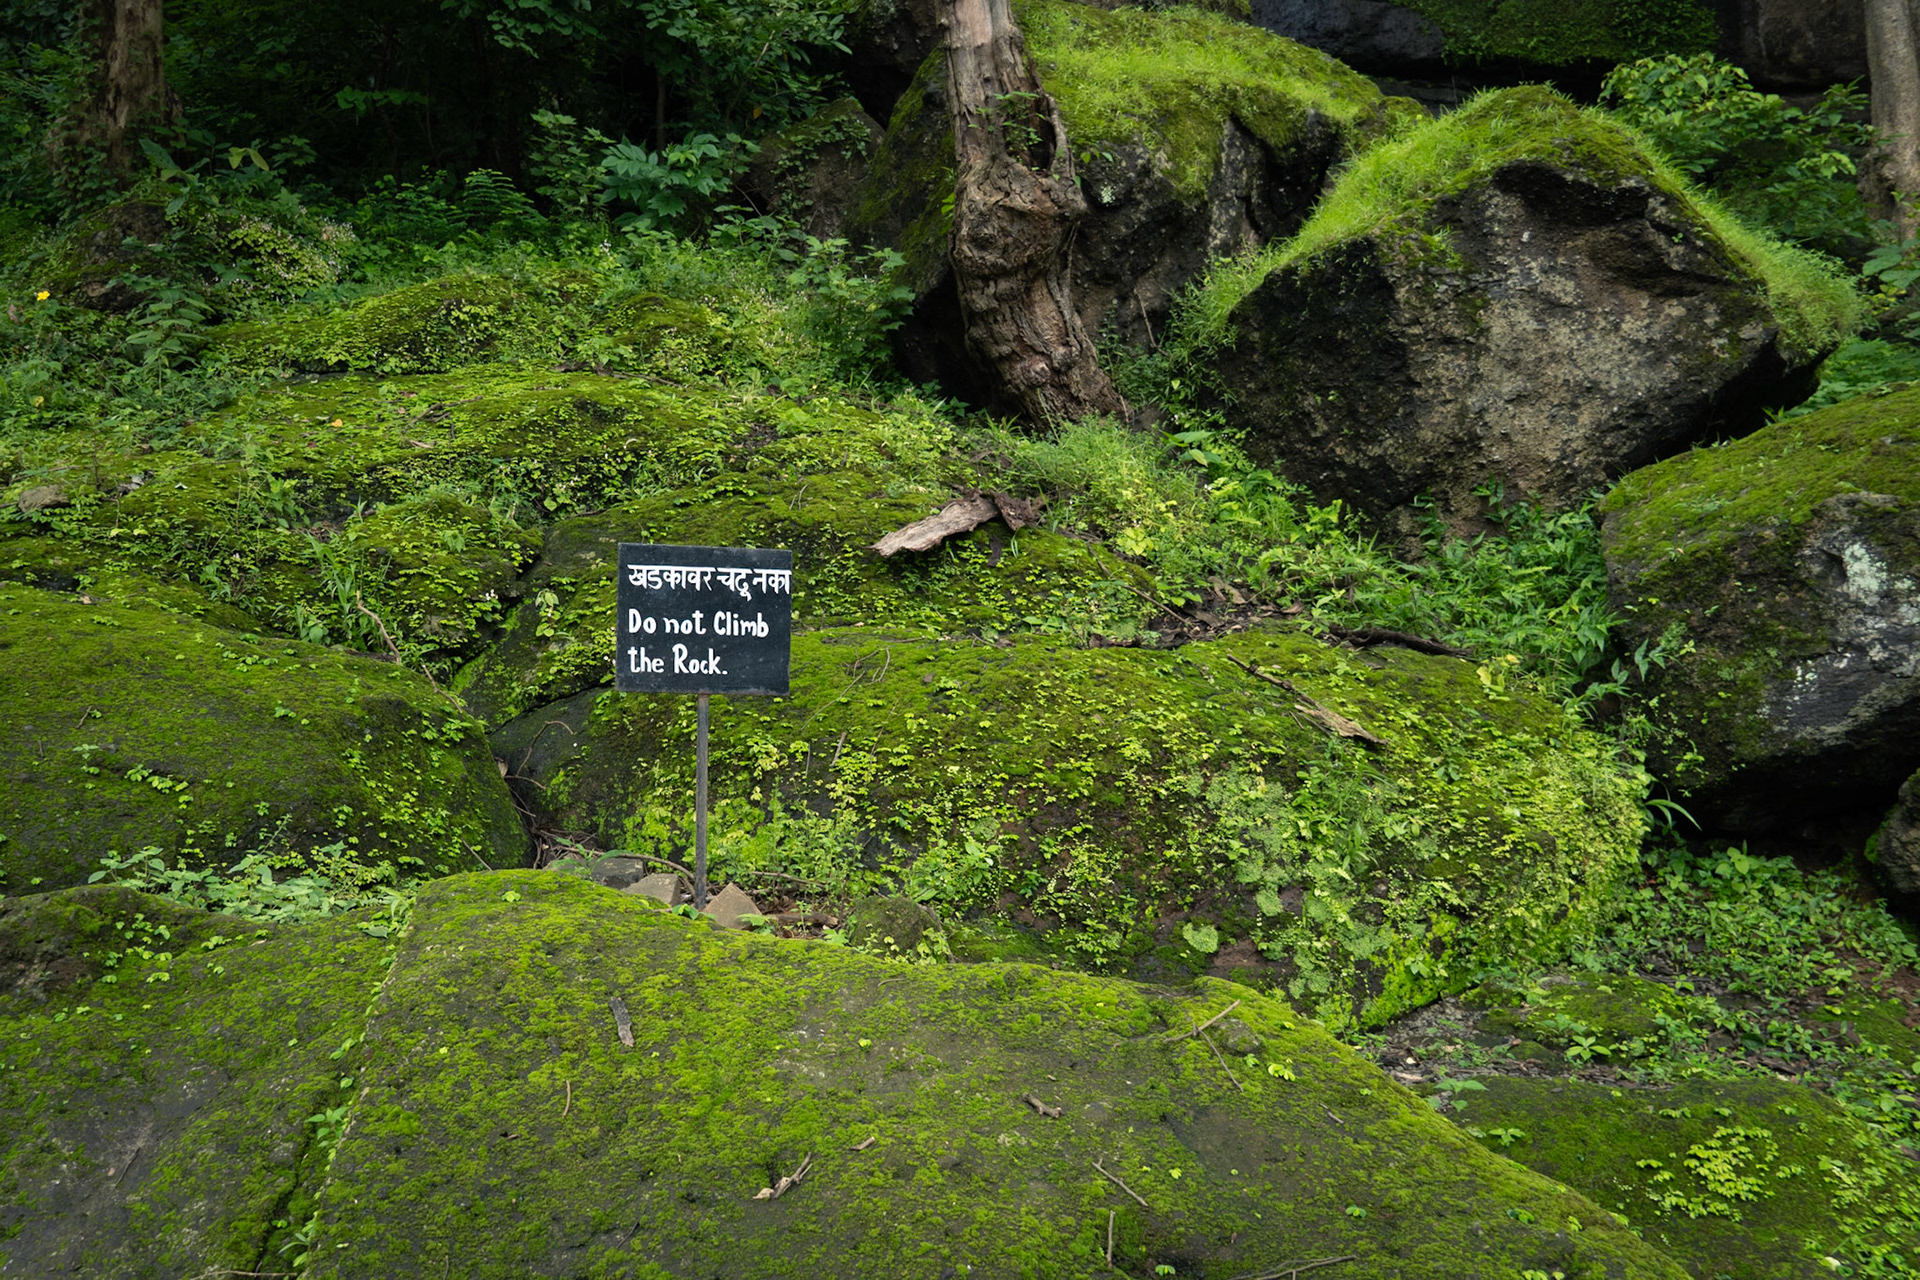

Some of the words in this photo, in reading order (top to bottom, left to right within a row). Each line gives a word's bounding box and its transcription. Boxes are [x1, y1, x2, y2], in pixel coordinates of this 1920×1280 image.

[627, 564, 717, 592] खडकावर
[752, 569, 793, 595] नका
[628, 608, 657, 634] Do
[663, 610, 707, 635] not
[713, 611, 769, 638] Climb
[628, 646, 664, 673] the
[672, 643, 728, 675] Rock.
